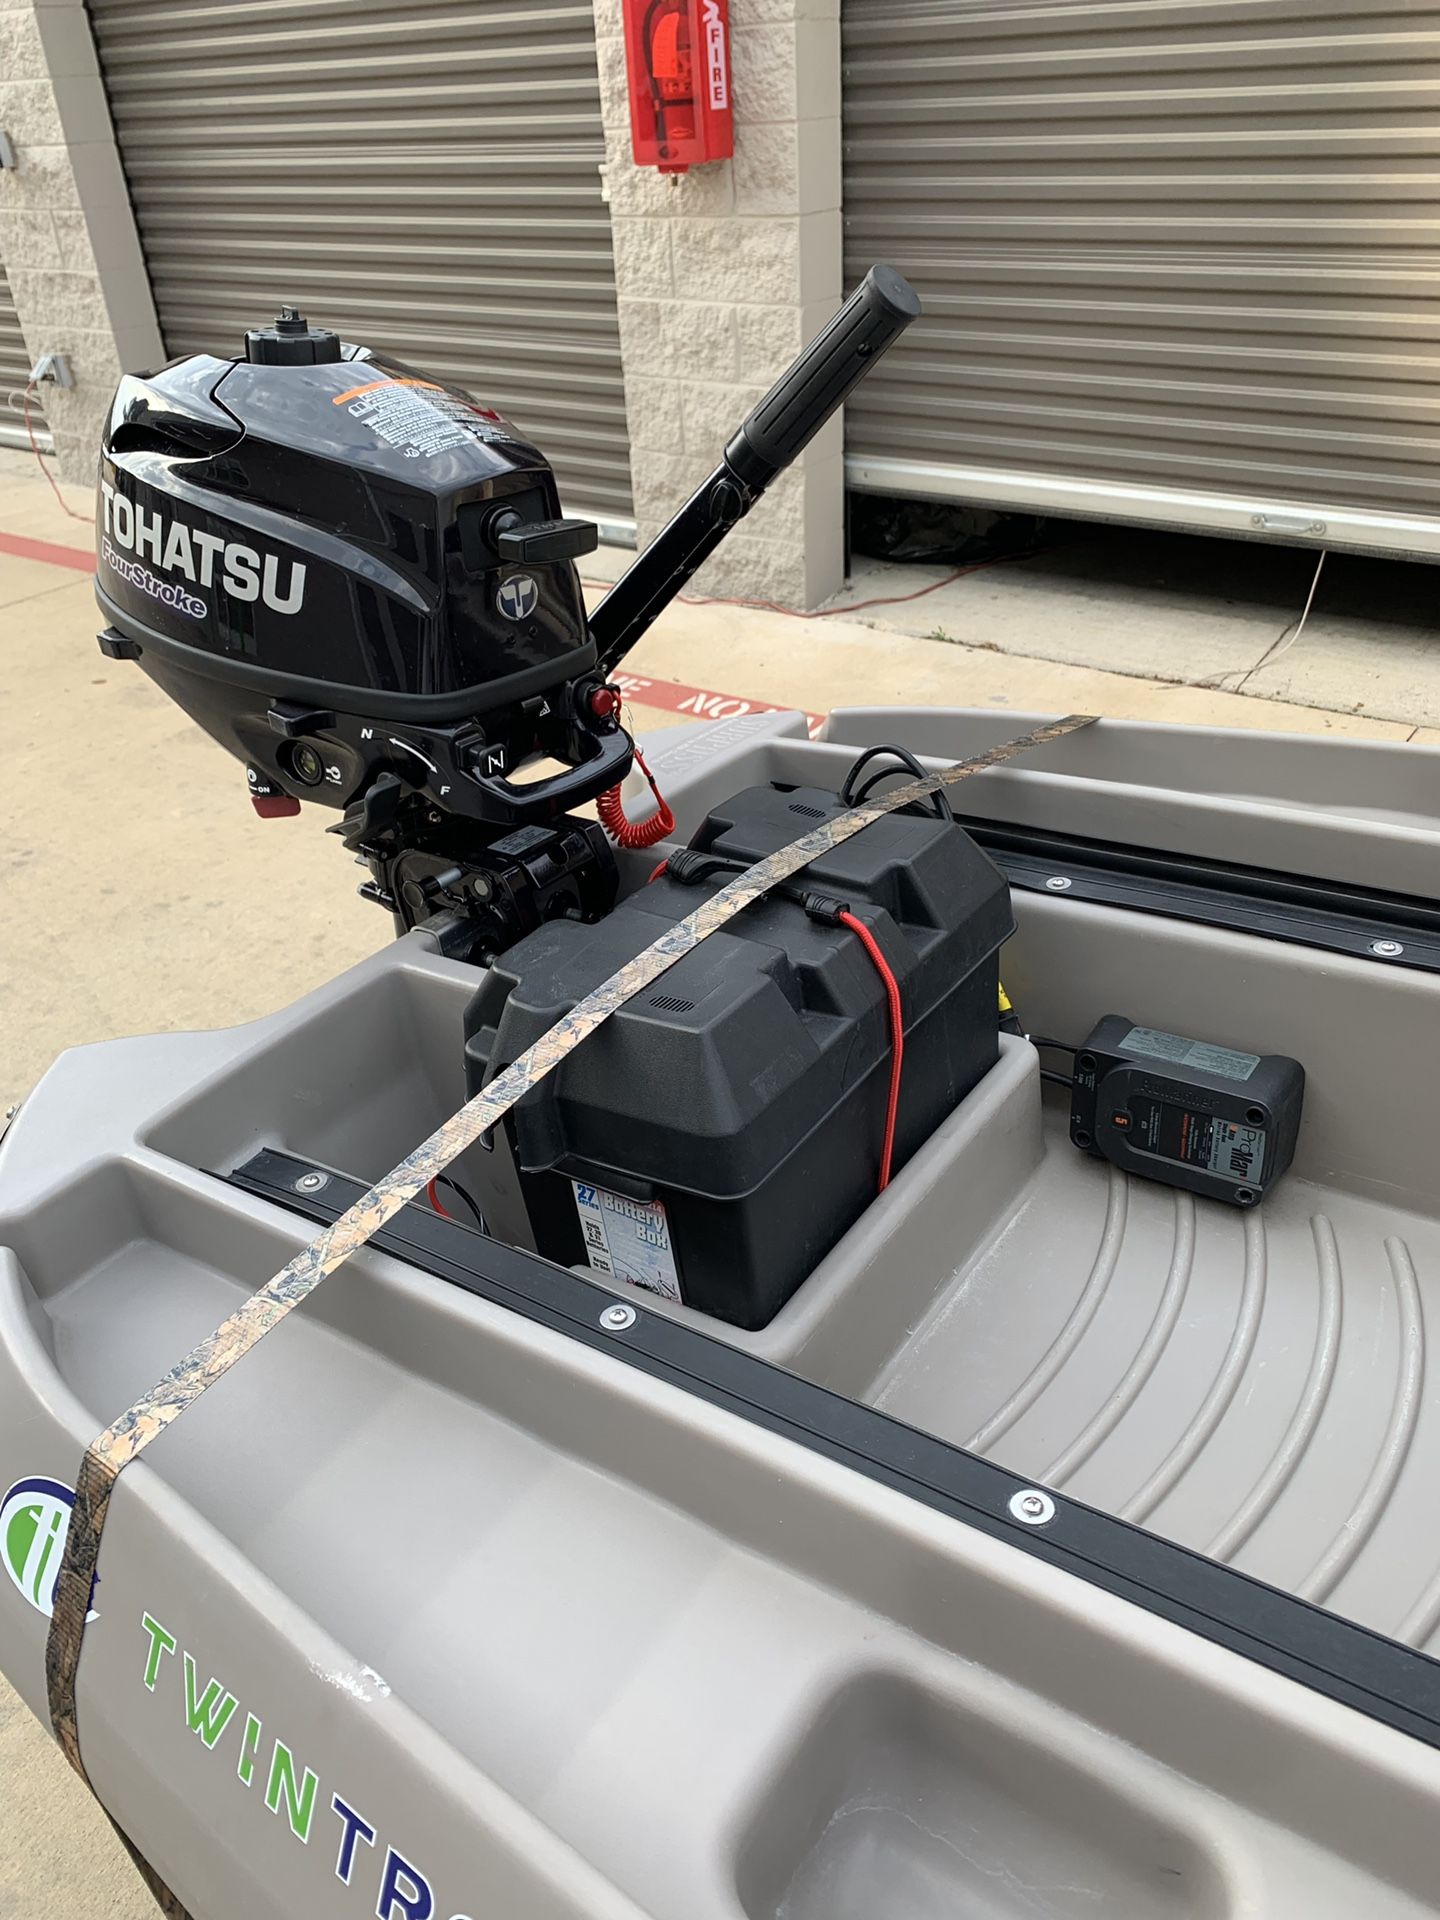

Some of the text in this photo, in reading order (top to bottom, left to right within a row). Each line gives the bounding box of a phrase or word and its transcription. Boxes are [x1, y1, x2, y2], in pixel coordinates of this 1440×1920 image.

[710, 28, 723, 101] FIRE
[101, 479, 307, 615] TOHATSU
[101, 535, 208, 619] FourStroke
[676, 692, 751, 720] NO
[360, 728, 374, 739] N
[257, 786, 270, 794] ON
[440, 785, 450, 796] F
[577, 1183, 596, 1203] 27
[602, 1191, 665, 1234] Battery
[636, 1223, 668, 1250] Box
[141, 1611, 466, 1920] TWINTR
